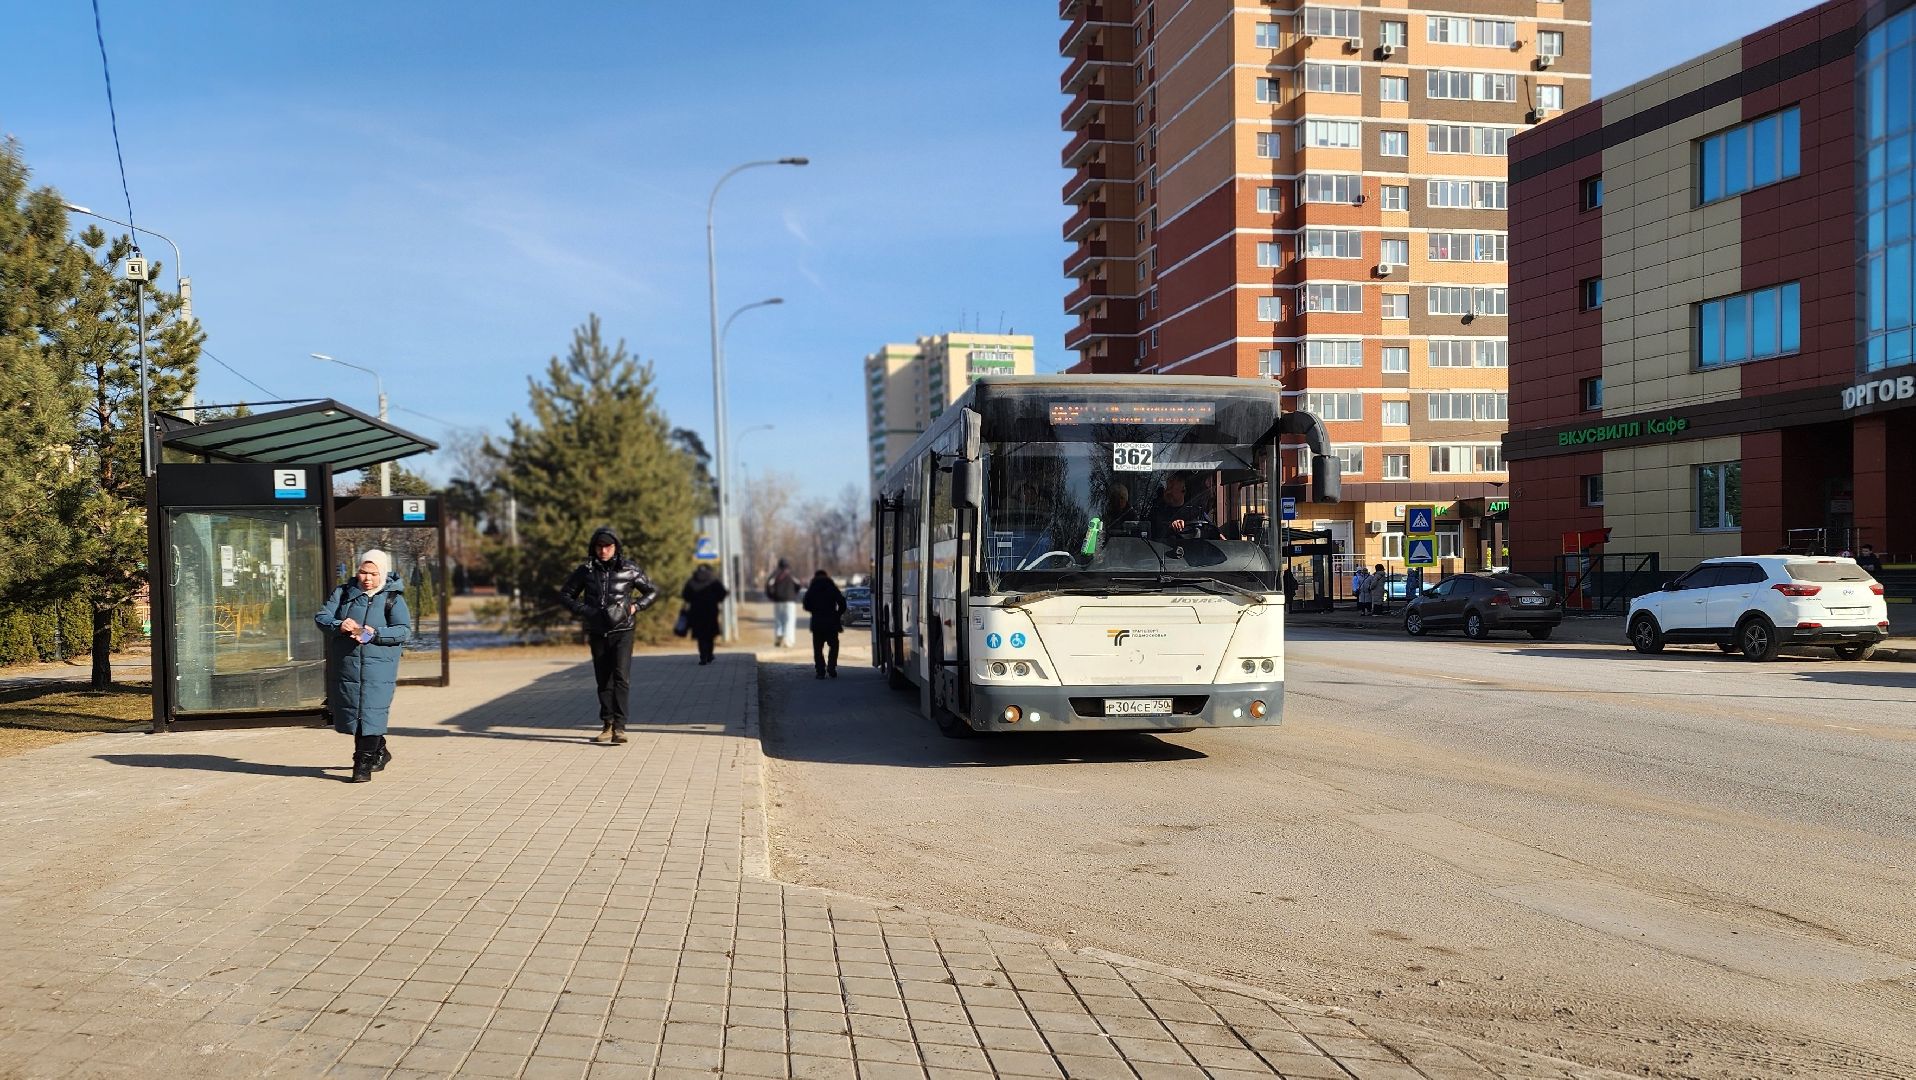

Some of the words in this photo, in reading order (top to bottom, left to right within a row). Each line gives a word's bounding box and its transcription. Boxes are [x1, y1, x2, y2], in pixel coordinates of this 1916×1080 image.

[1559, 422, 1639, 446] ВКУСВИЛЛ
[1647, 416, 1686, 435] Кафе
[1114, 448, 1152, 465] 362
[1152, 700, 1169, 709] 750
